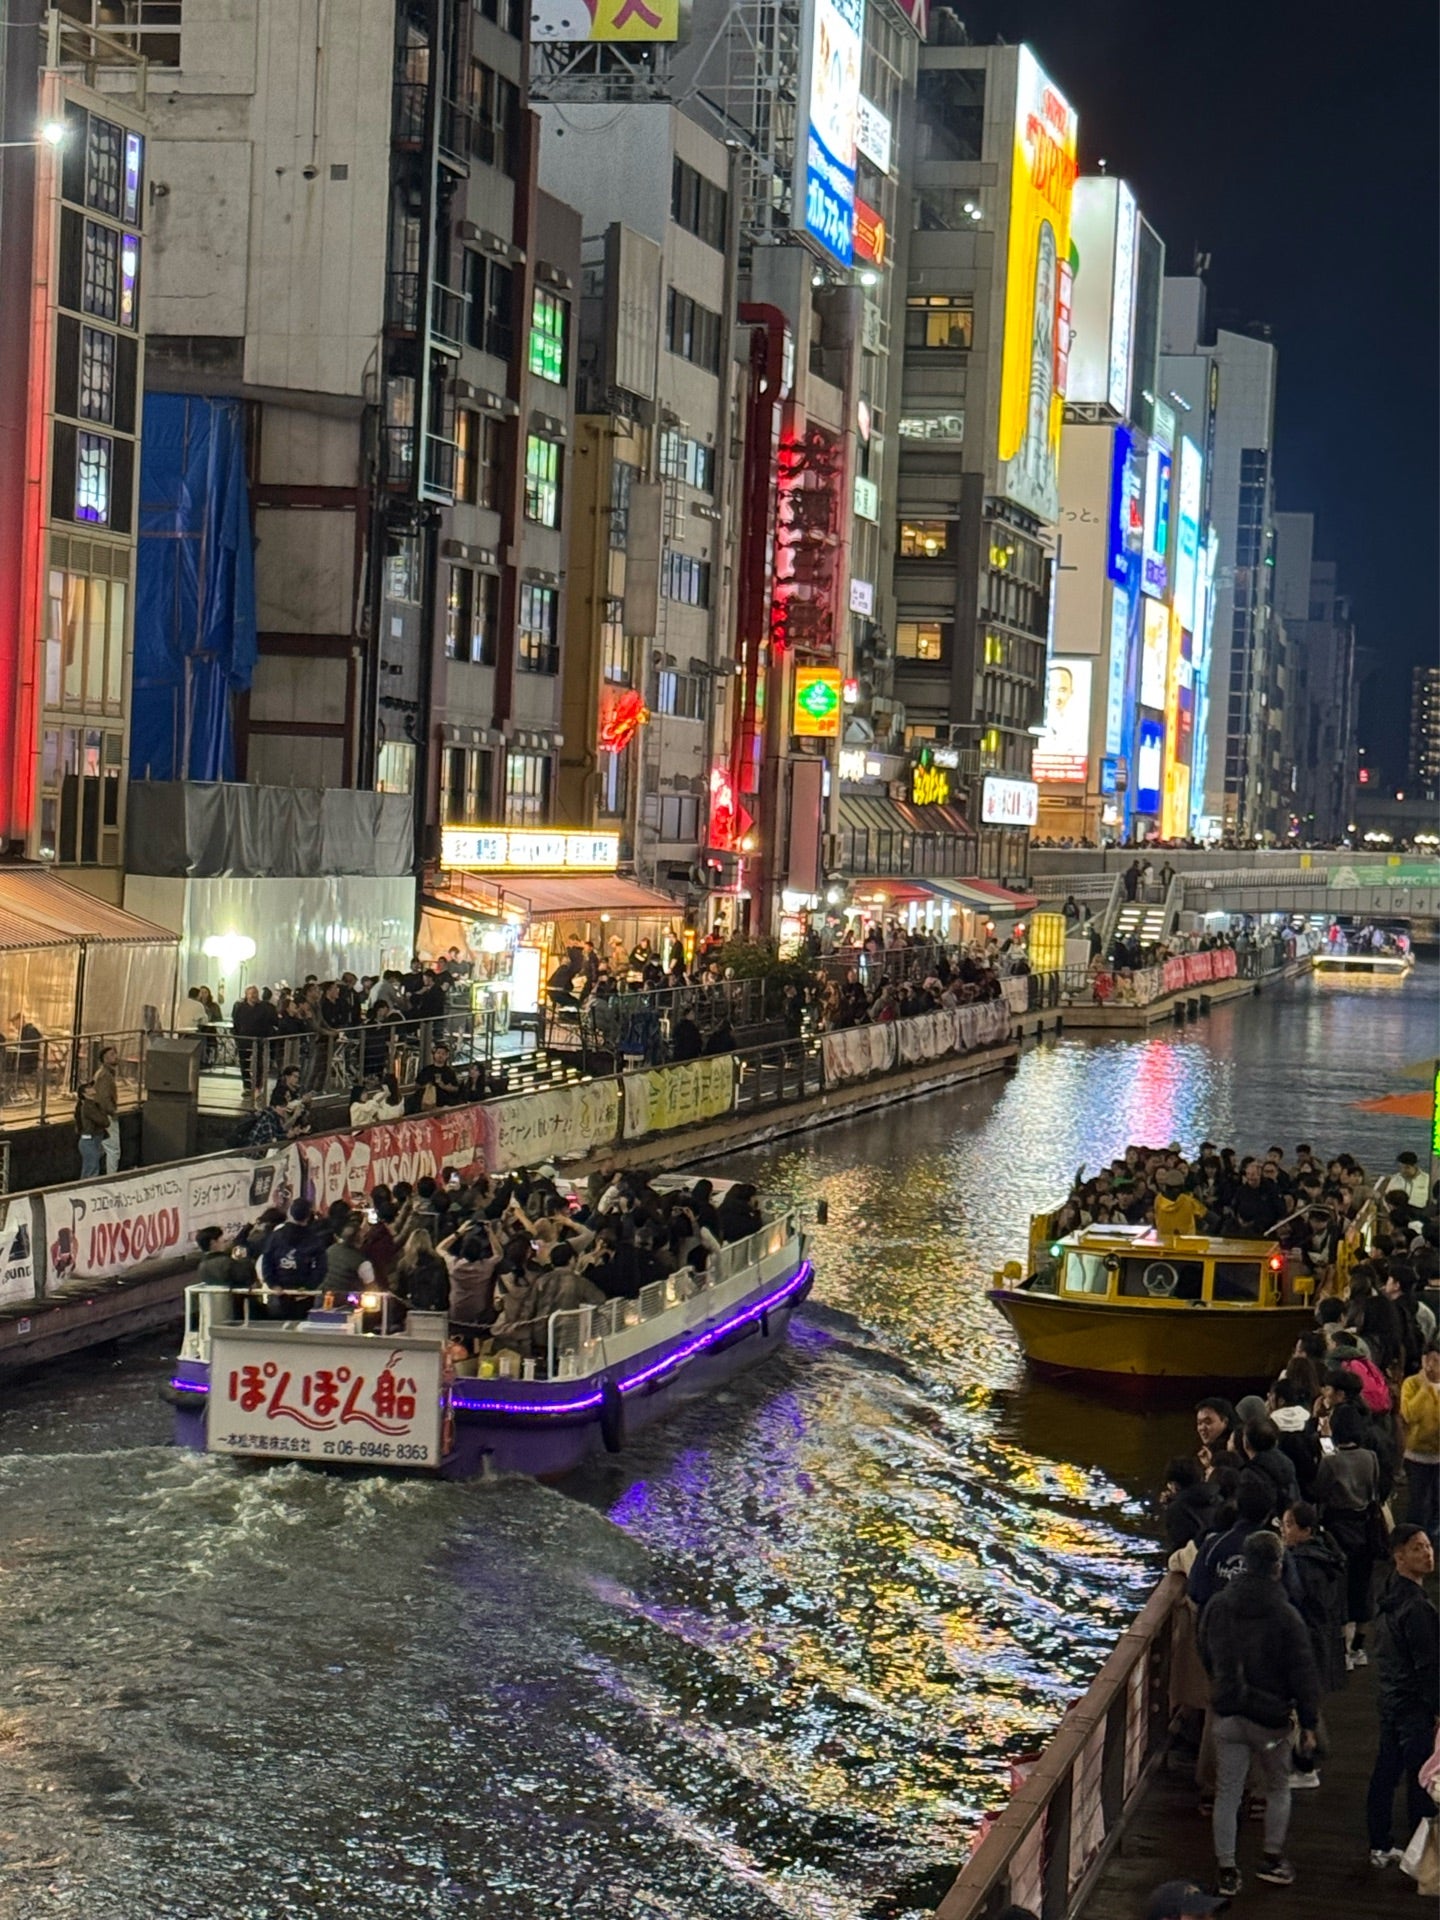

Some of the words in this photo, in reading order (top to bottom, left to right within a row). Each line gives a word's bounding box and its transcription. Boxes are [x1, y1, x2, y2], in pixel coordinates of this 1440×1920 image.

[1059, 507, 1100, 524] っと。
[87, 1206, 180, 1269] JOYSOUND
[228, 1360, 417, 1436] ぽんぽん船
[337, 1440, 429, 1460] 06-6946-8363
